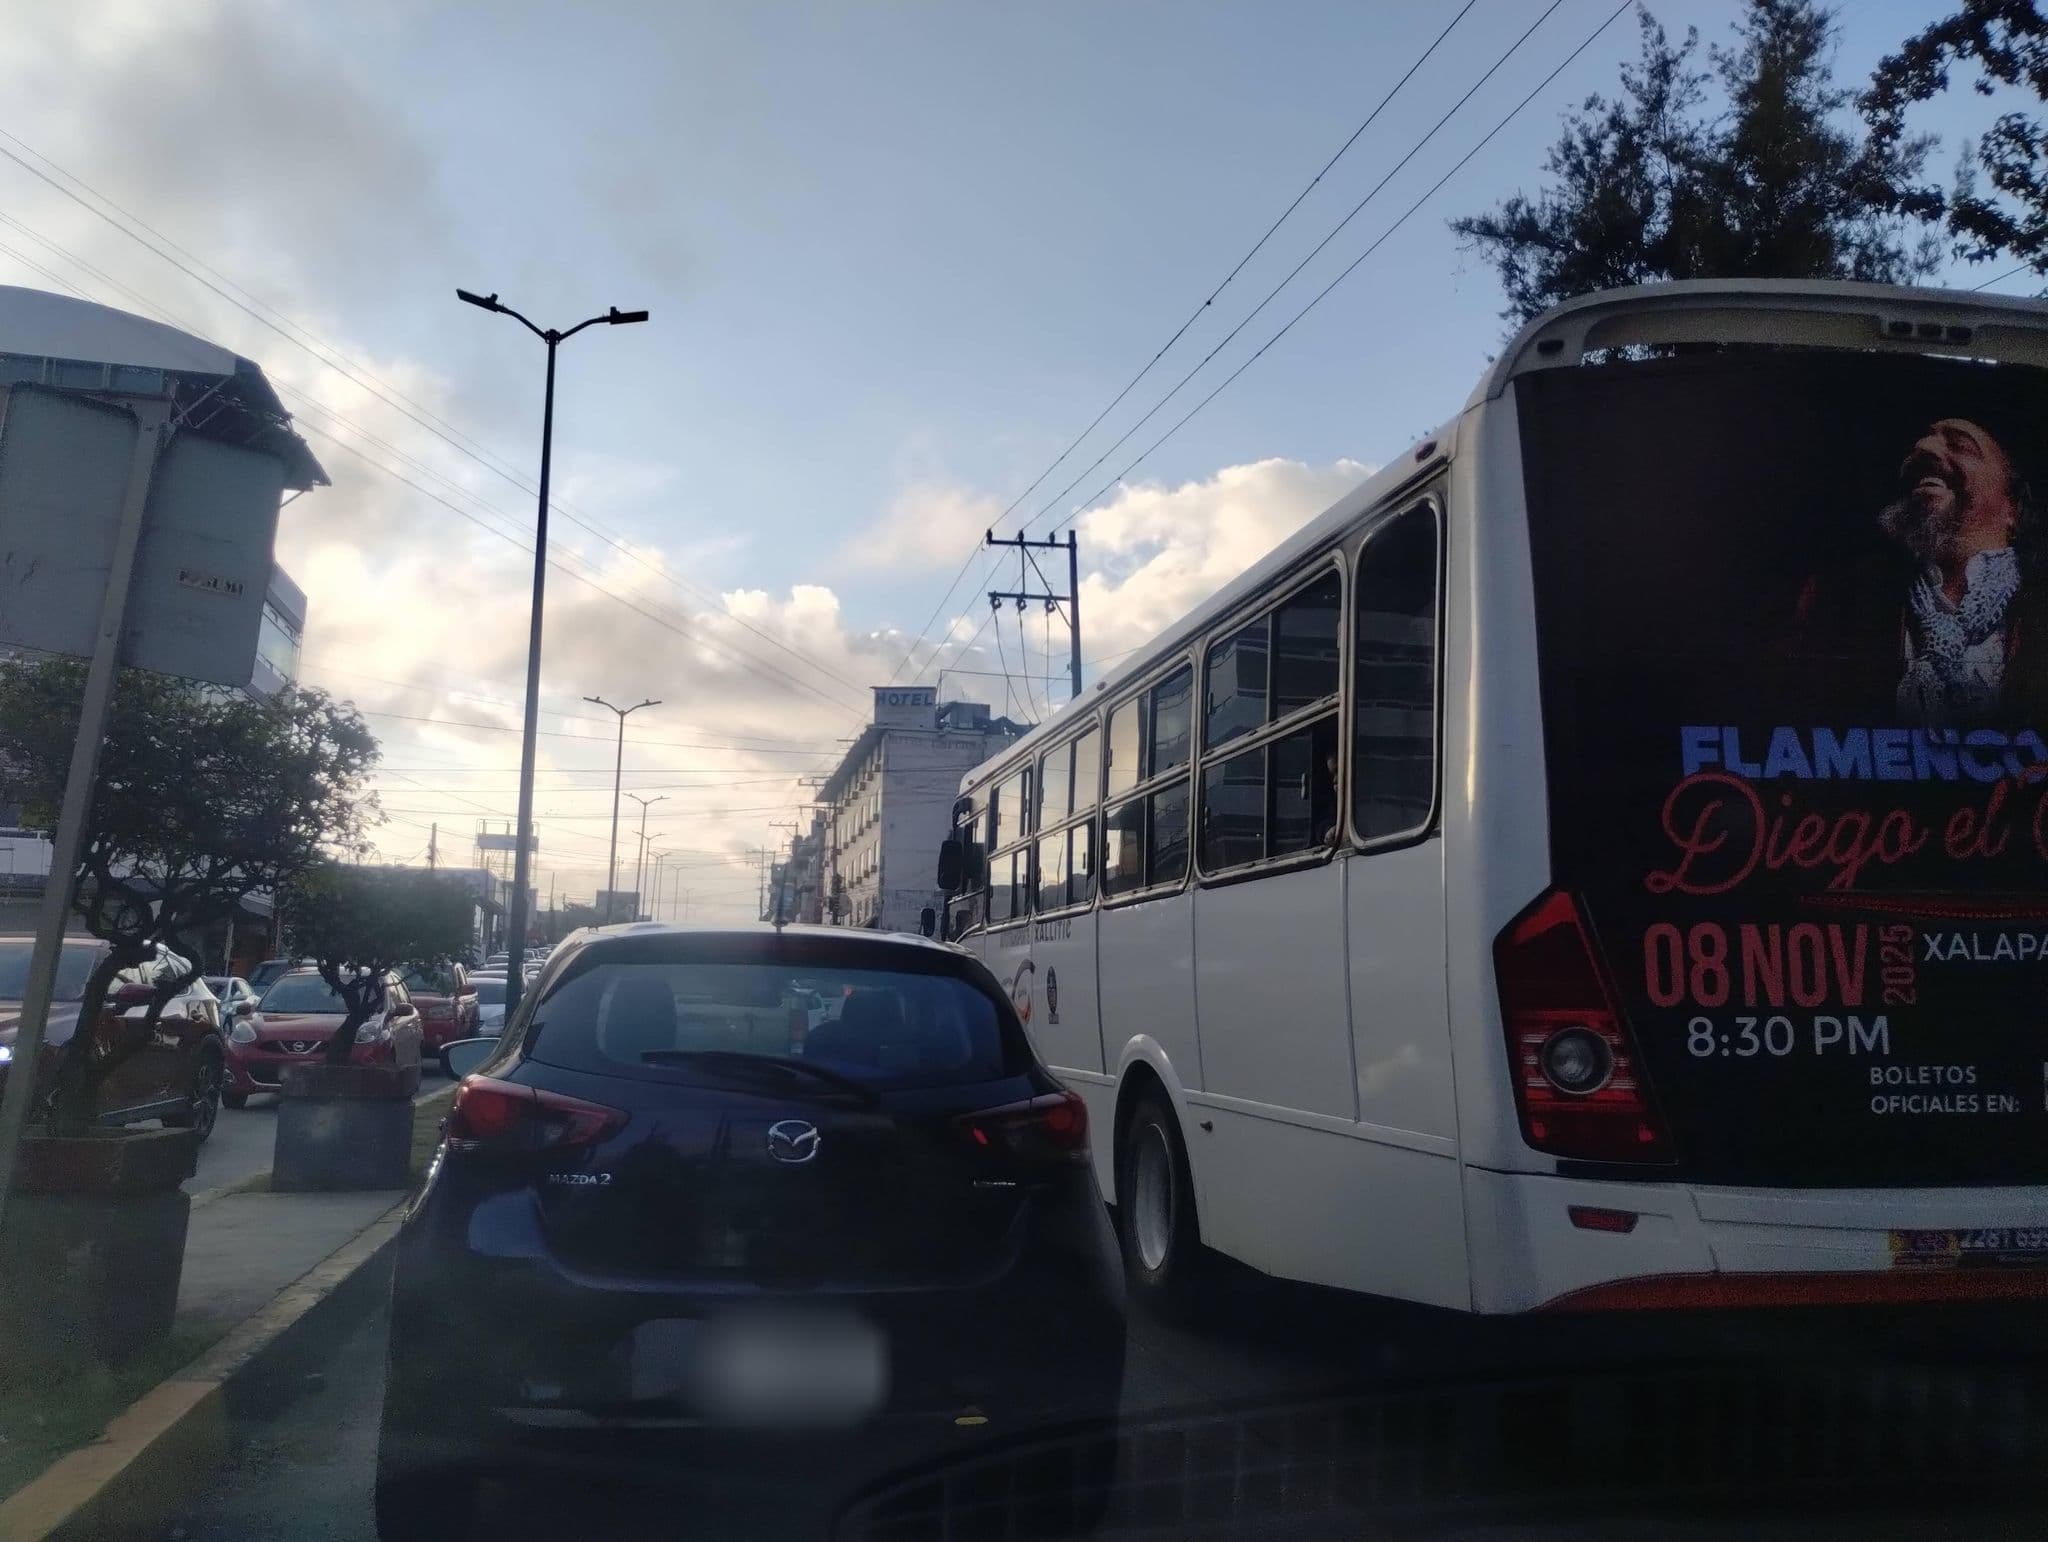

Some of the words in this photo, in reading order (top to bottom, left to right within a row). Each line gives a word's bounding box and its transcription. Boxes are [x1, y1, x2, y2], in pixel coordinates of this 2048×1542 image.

[876, 692, 934, 706] HOTEL
[1644, 773, 1929, 894] Diego
[1943, 780, 2011, 862] el
[1644, 922, 1730, 1008] 08
[1740, 923, 1869, 1007] NOV
[1880, 924, 1916, 1007] 2025
[1687, 1016, 1795, 1058] 8:30
[1813, 1015, 1891, 1056] PM
[1870, 1065, 1977, 1086] BOLETOS
[1871, 1095, 1979, 1115] OFICIALES
